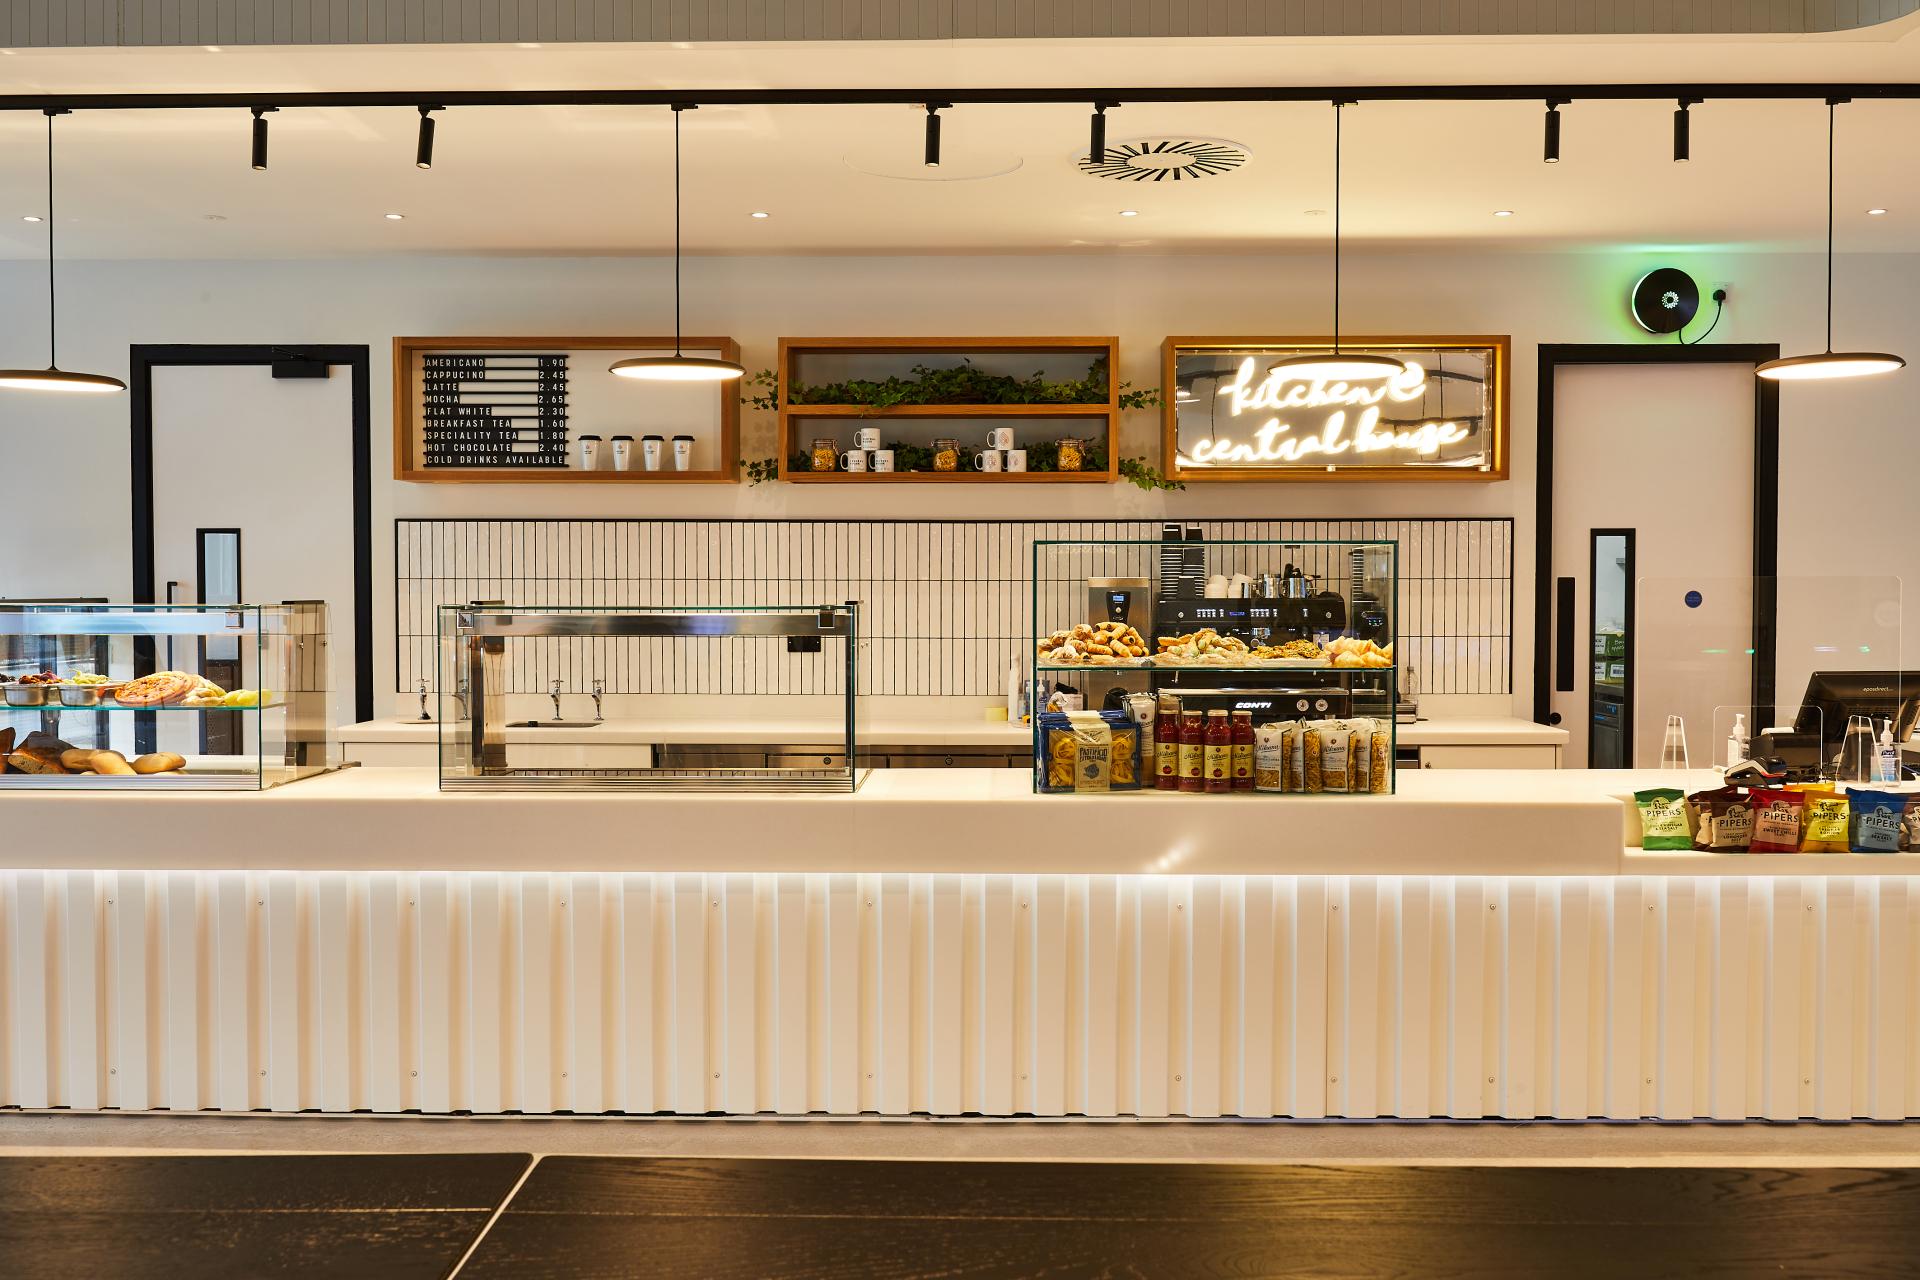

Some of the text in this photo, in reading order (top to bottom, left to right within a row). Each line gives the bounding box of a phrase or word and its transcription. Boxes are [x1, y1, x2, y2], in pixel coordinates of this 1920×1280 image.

[426, 359, 564, 367] AMERICANO 1.90
[426, 371, 564, 379] CAPPUCINO 2.45
[427, 383, 564, 391] LATTE 2.45
[426, 395, 564, 403] MOCHA 2.65
[427, 407, 564, 416] FLAT WHITE 2.30
[427, 419, 564, 427] BREAKFAST TEA 1.60
[427, 431, 564, 439] SPECIALITY TEA 1.80
[1192, 406, 1468, 462] central house
[427, 443, 564, 452] HOT CHOCOLATE 2.40
[427, 455, 563, 464] COLD DRINKS AVAILABLE
[1646, 807, 1682, 817] PIPERS
[1813, 812, 1846, 820] PIPERS
[1763, 811, 1800, 823] PIPERS
[1719, 818, 1752, 827] PIPERS
[1866, 816, 1900, 830] PIPERS
